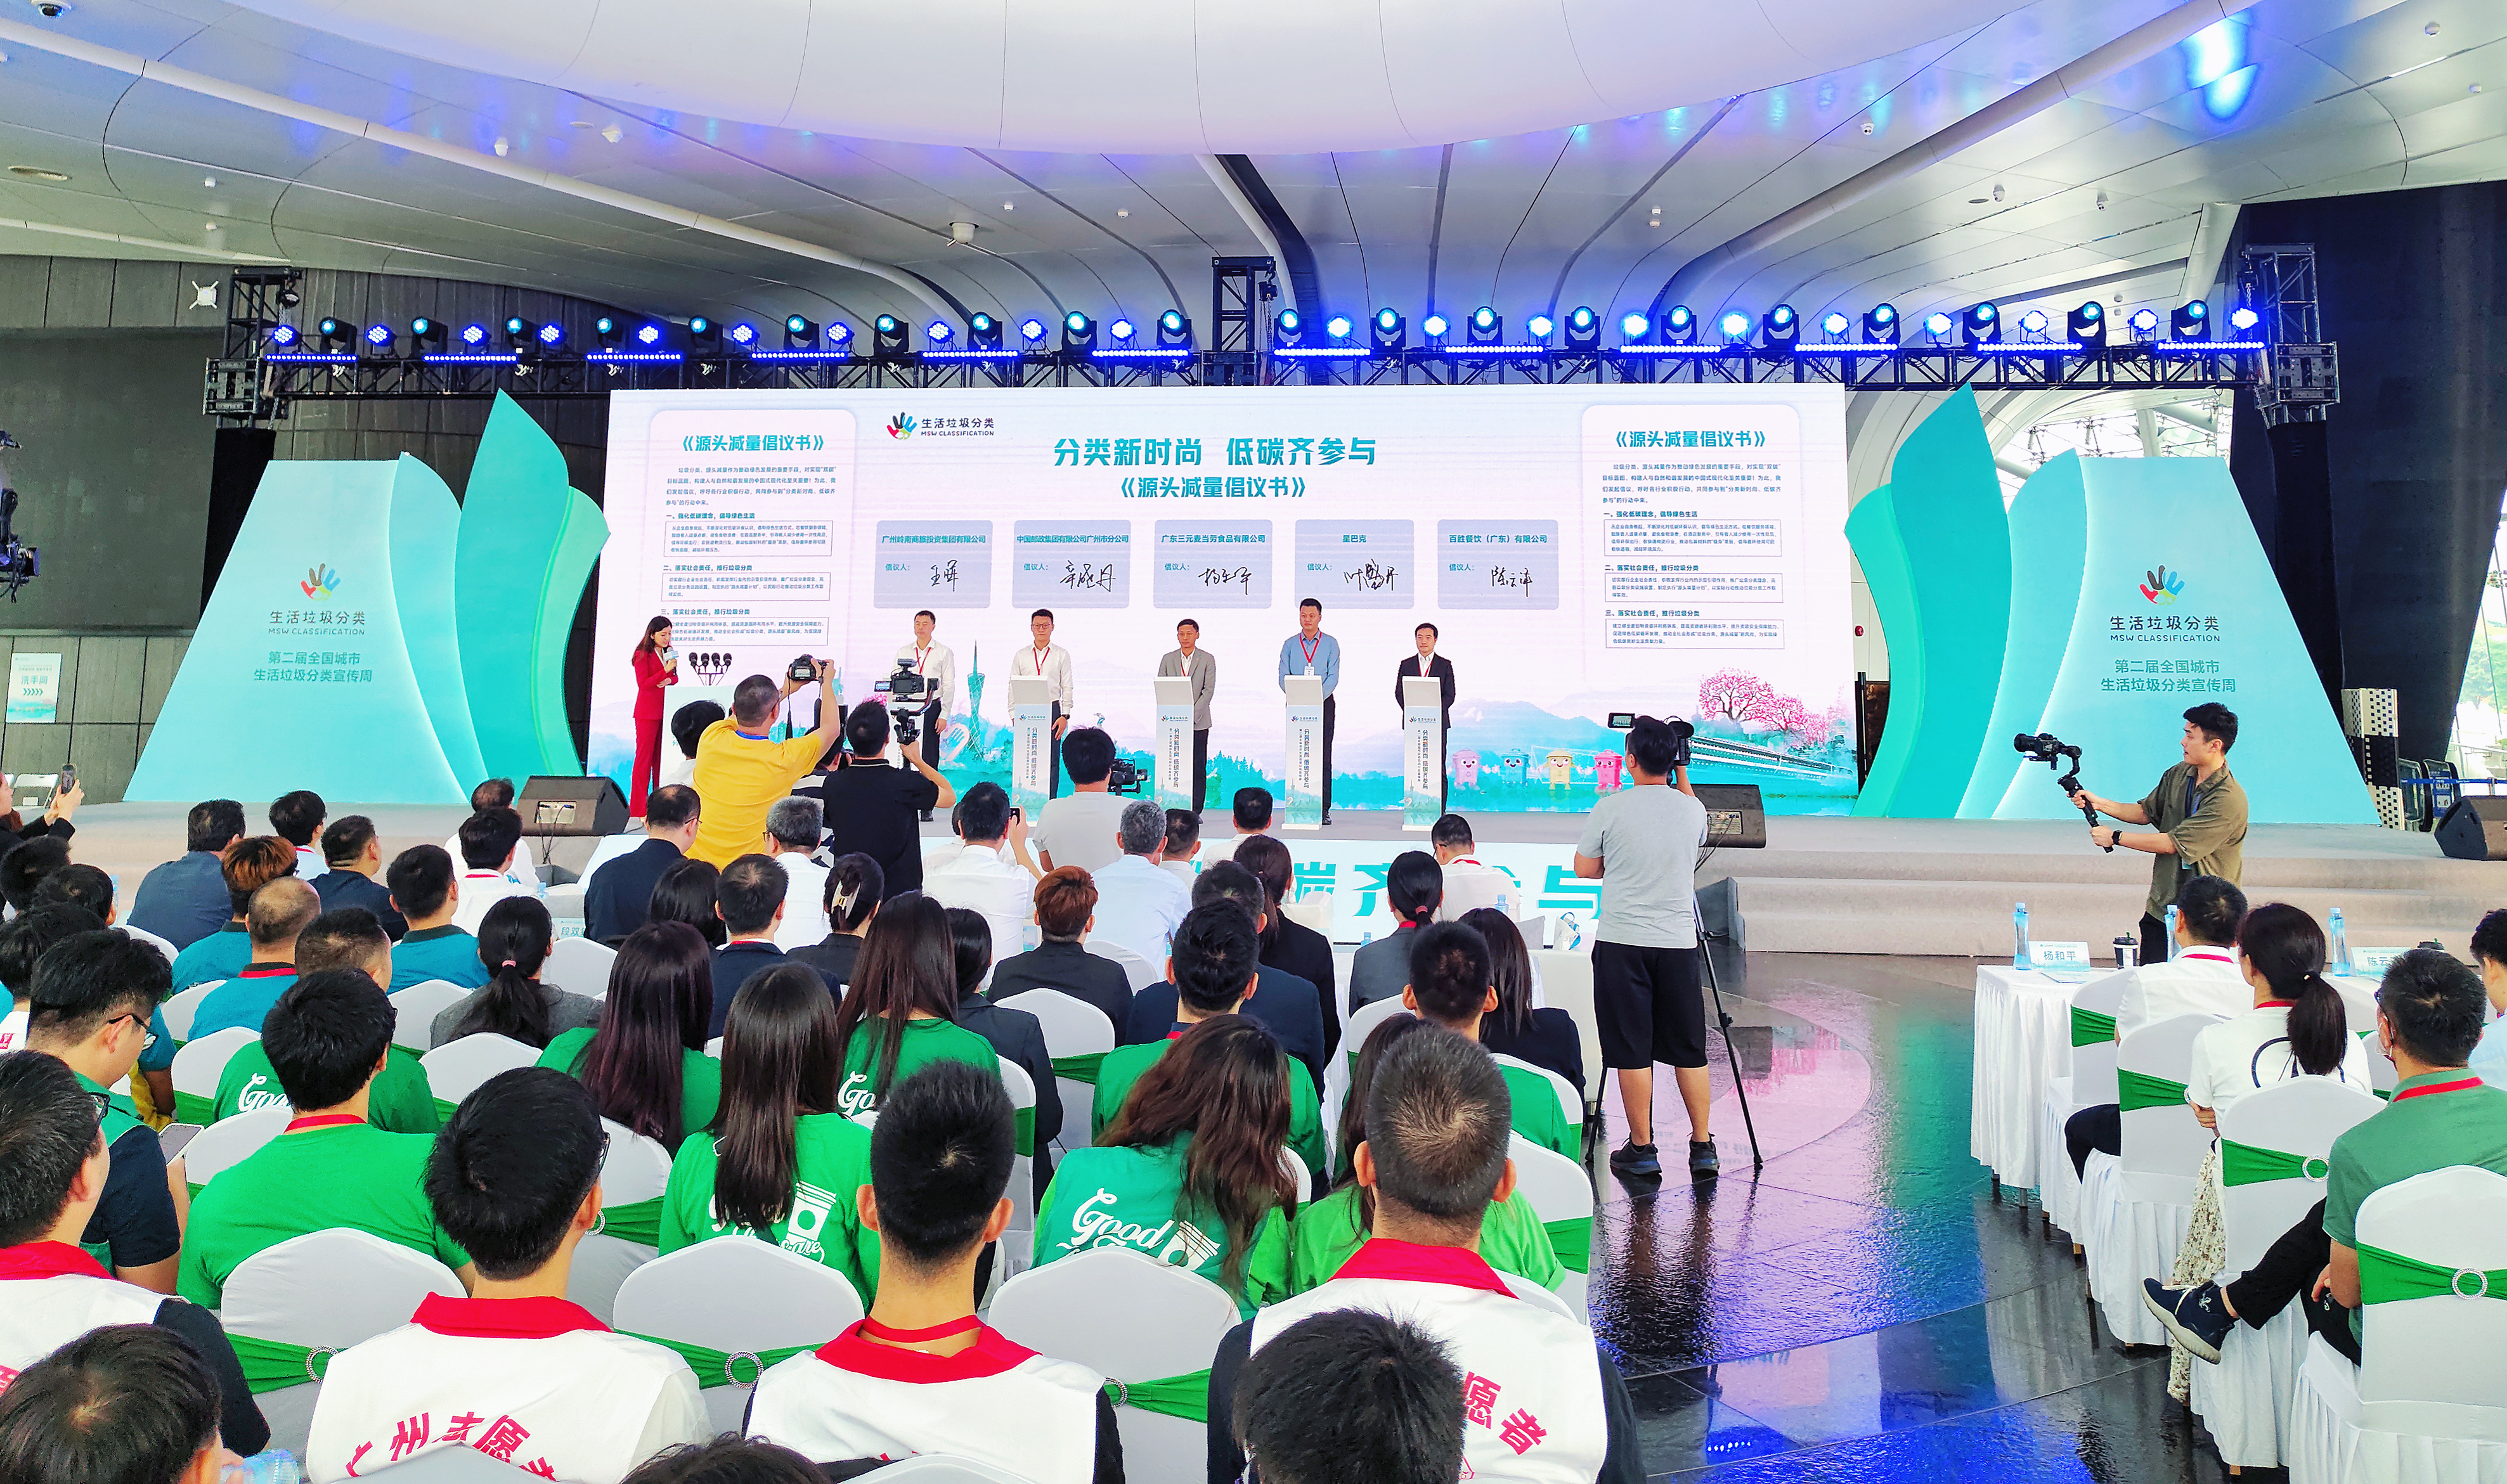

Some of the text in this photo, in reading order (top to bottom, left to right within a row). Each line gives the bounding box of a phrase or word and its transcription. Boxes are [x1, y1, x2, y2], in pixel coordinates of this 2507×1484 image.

[921, 418, 994, 429] 生活垃圾分类
[682, 434, 824, 452] 《源头减量倡议书》
[1616, 430, 1766, 448] 《源头减量倡议书》
[1054, 437, 1377, 467] 分类新时尚 低碳齐参与
[1121, 476, 1306, 498] 《源头减量倡议书》
[881, 534, 986, 544] 广州岭南商旅投资集团有限公司
[1016, 534, 1129, 544] 中国邮政集团有限公司广州市分公司
[1161, 534, 1266, 543] 广东三元麦当劳食品有限公司
[1342, 534, 1367, 543] 星巴克
[1449, 534, 1548, 544] 百胜餐饮（广东）有限公司
[269, 610, 366, 625] 生活垃圾分类
[2109, 615, 2220, 631] 生活垃圾分类
[2137, 634, 2221, 642] CLASSIFICATION
[268, 651, 361, 666] 第二届全国城市
[2115, 659, 2220, 674] 第二届全国城市
[253, 668, 373, 683] 生活垃圾分类宣传周
[2100, 678, 2237, 693] 生活垃圾分类宣传周
[2044, 950, 2076, 961] 杨和平
[2367, 957, 2394, 967] 陈云
[838, 1071, 876, 1116] Go
[1071, 1187, 1175, 1248] Good
